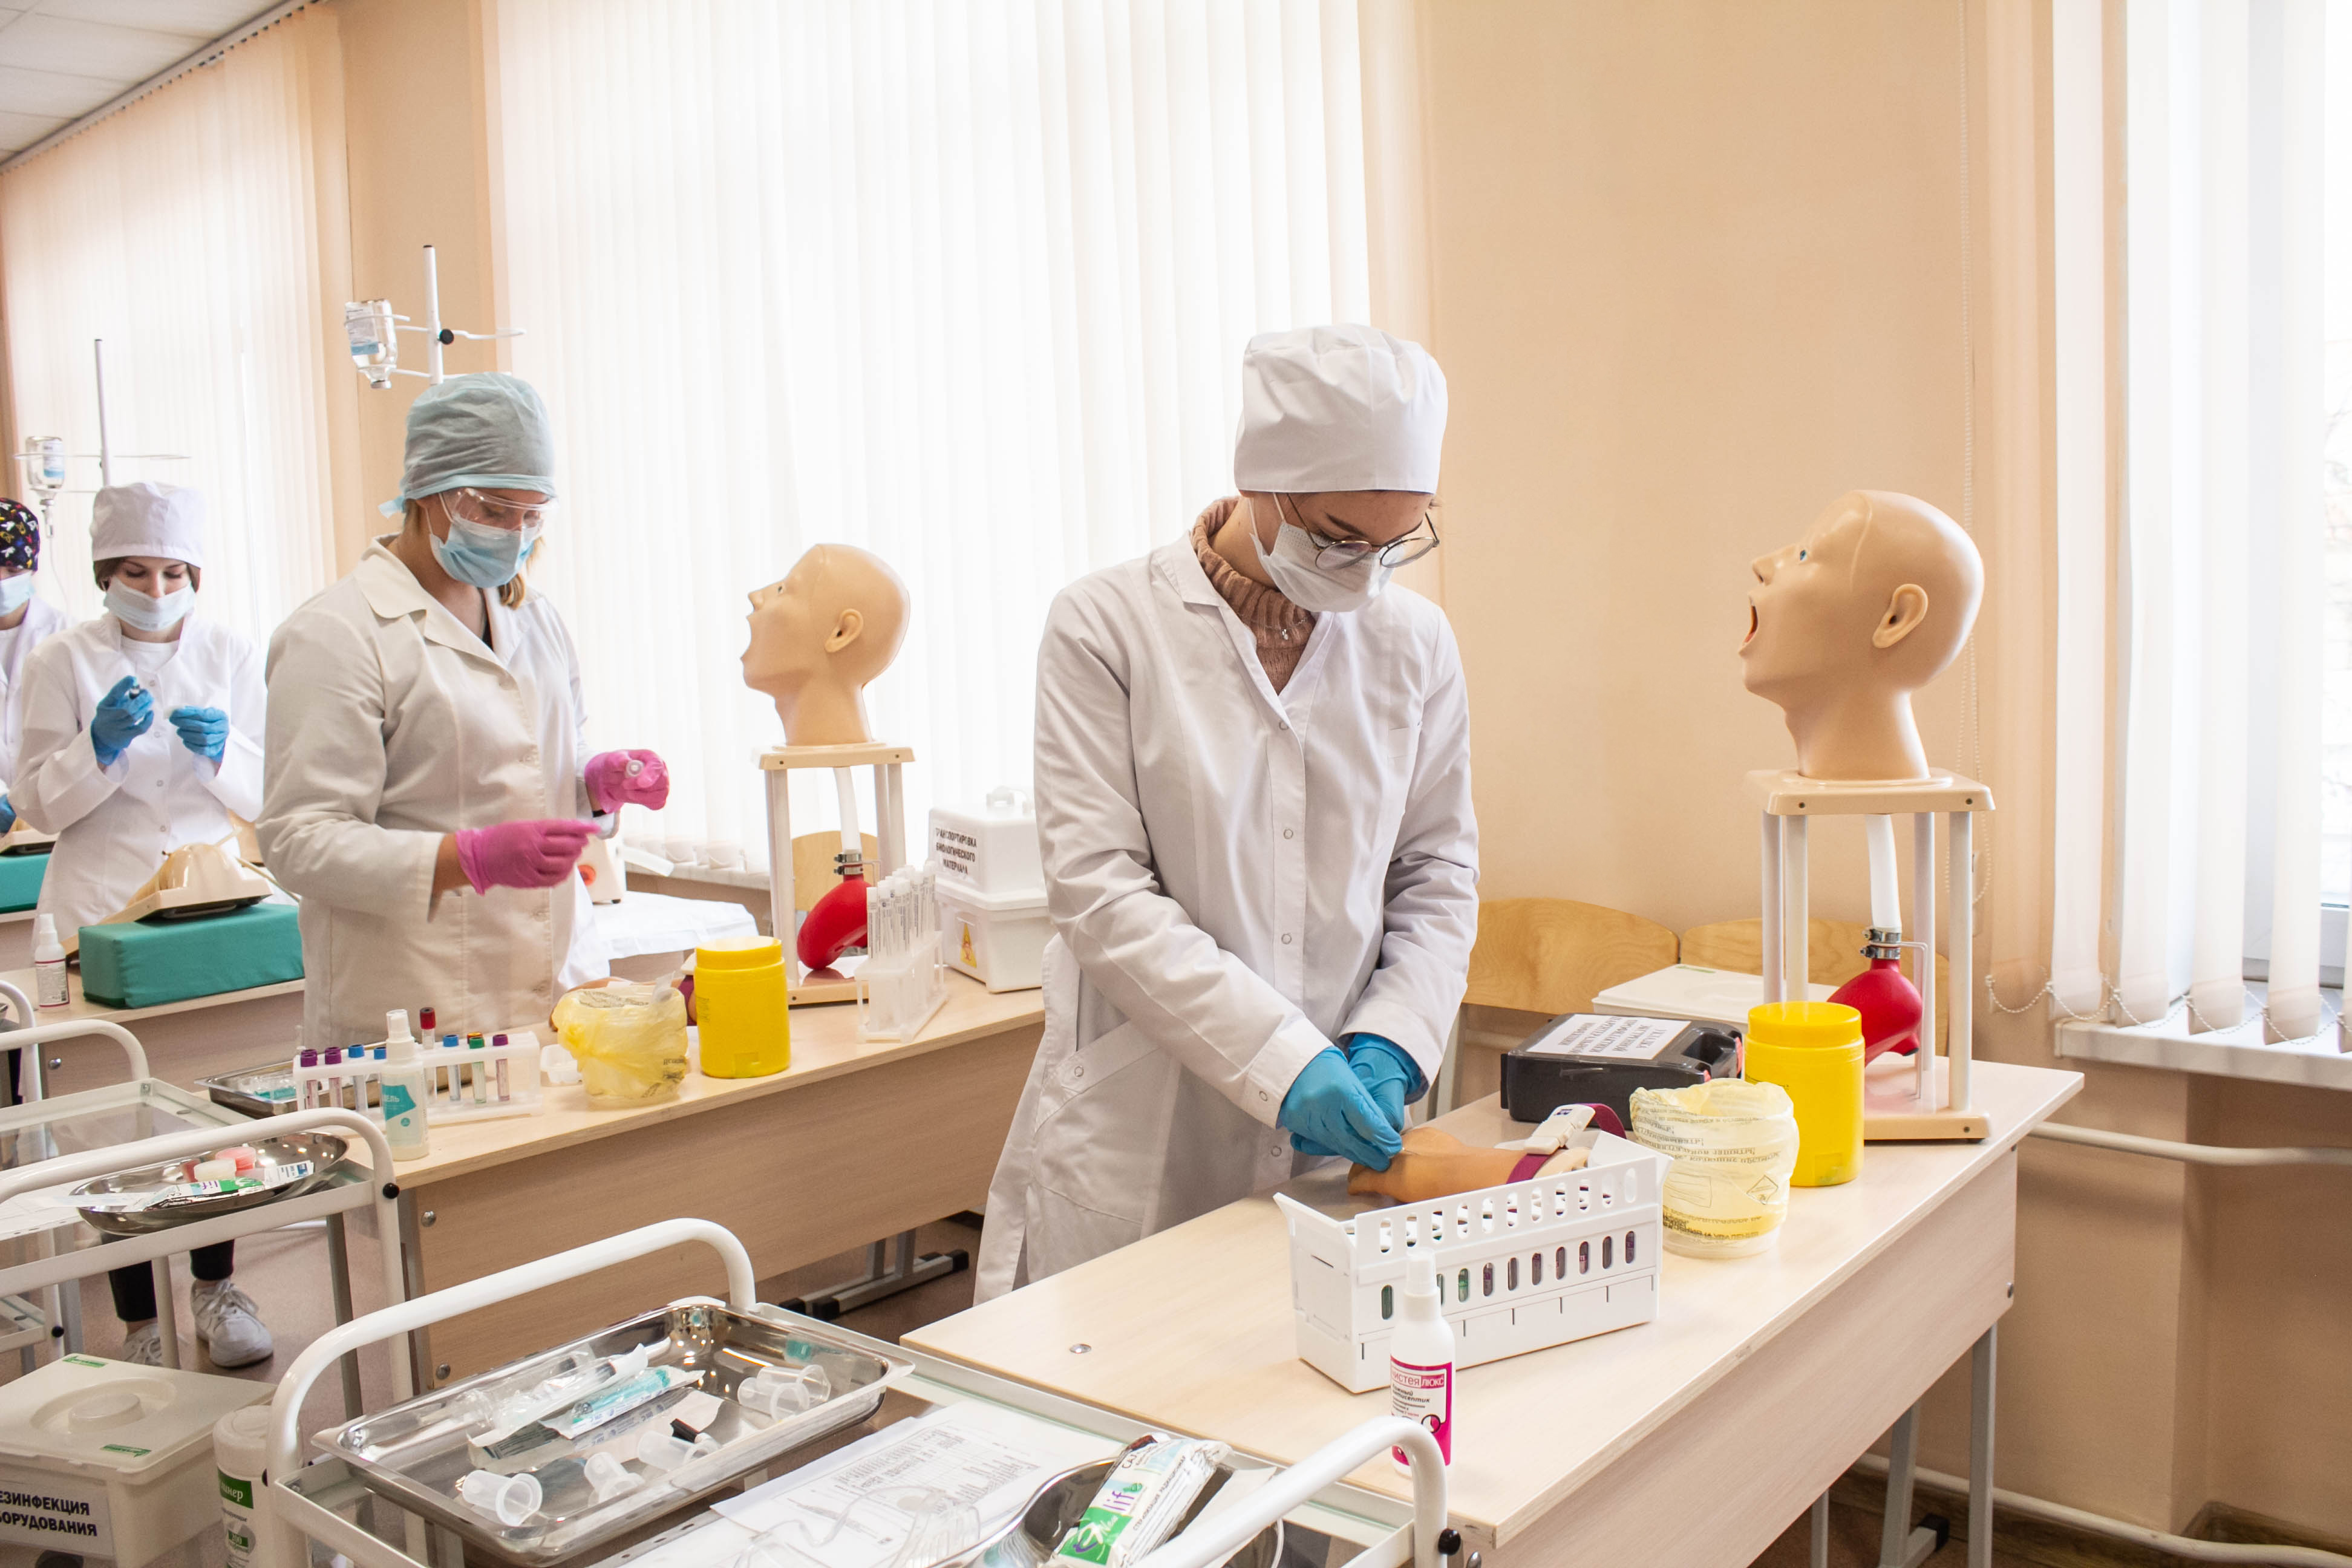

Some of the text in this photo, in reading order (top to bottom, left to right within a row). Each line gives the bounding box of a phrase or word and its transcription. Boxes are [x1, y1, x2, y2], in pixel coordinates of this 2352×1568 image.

[935, 827, 977, 848] ТРАНСПОРТИРОВКА
[936, 841, 975, 862] БИОЛОГИЧЕСКОГО
[943, 858, 968, 875] МАТЕРИАЛА
[0, 1512, 97, 1536] ОРУДОВАНИЯ
